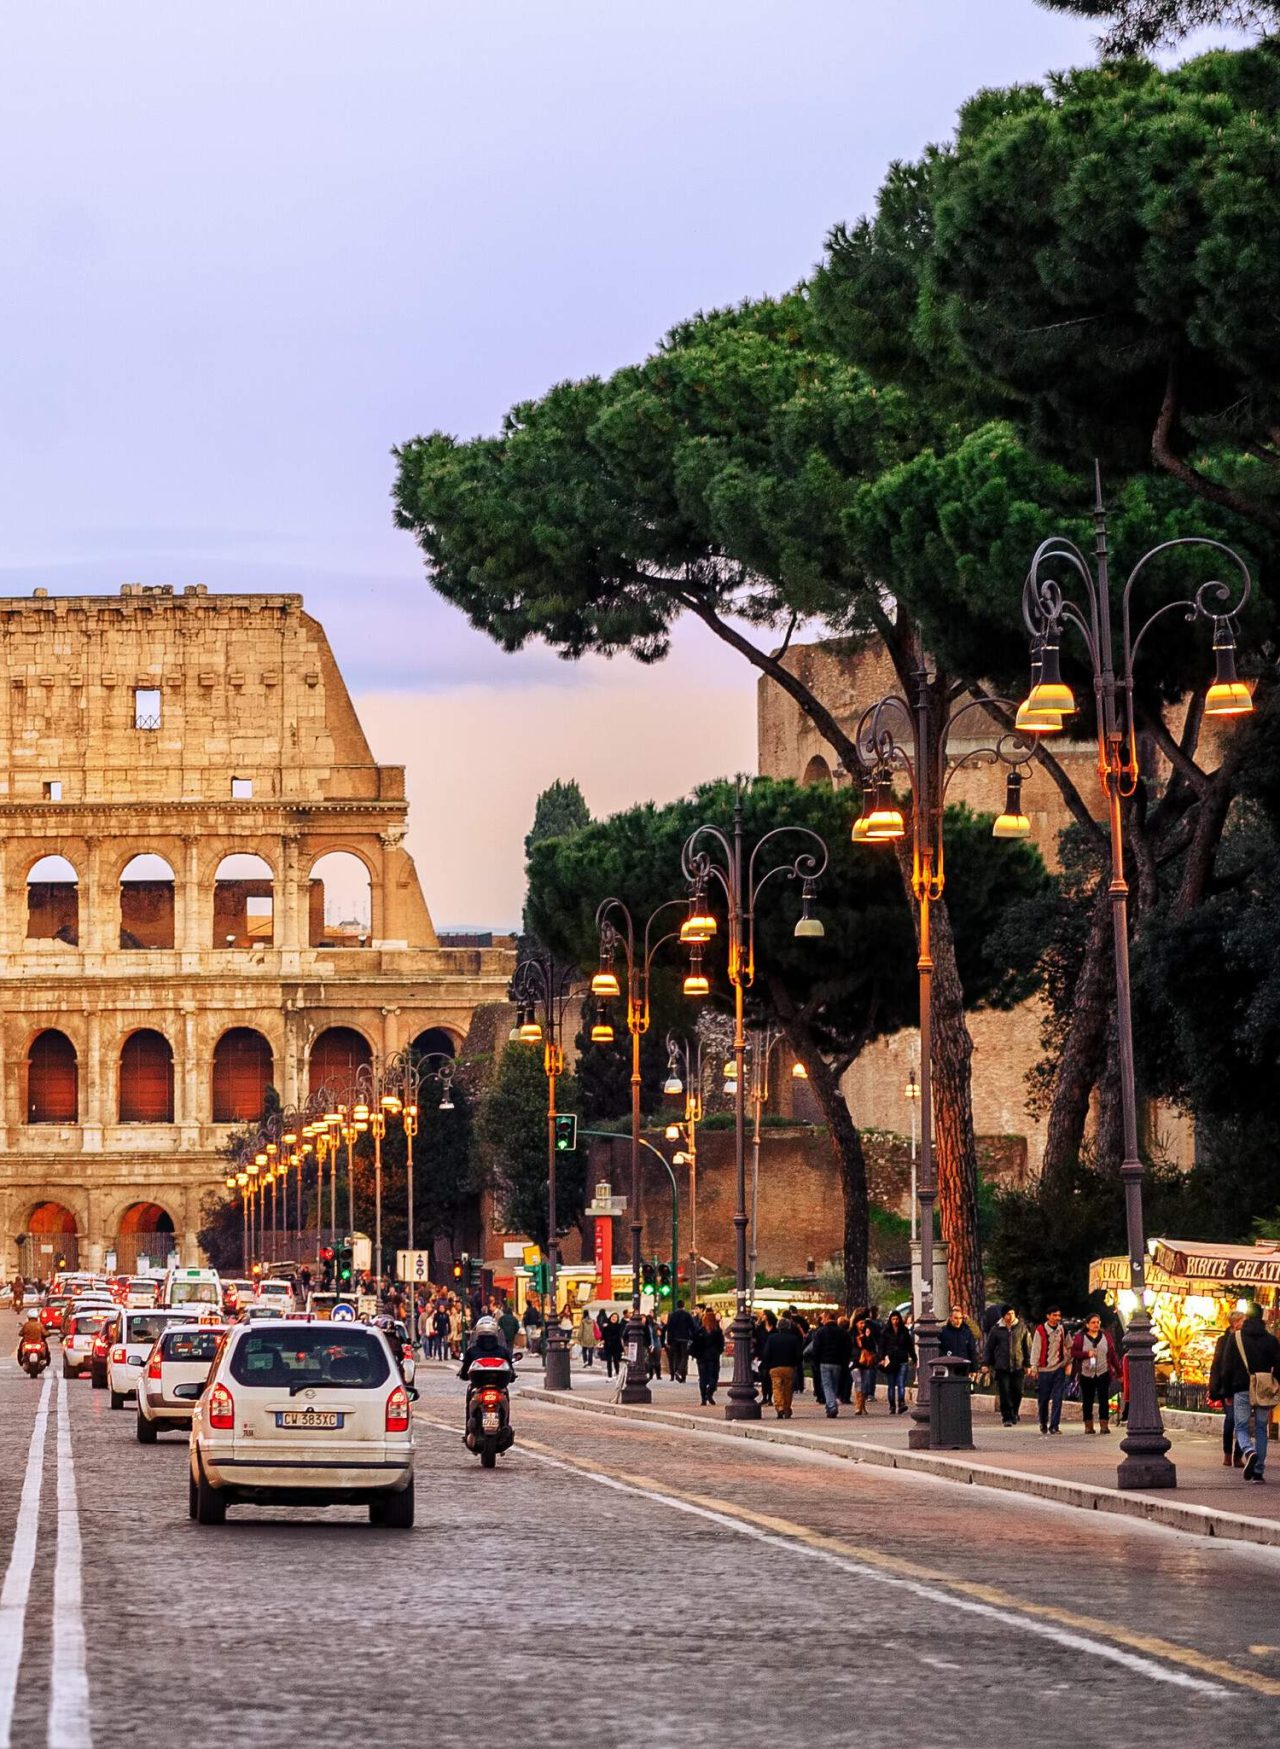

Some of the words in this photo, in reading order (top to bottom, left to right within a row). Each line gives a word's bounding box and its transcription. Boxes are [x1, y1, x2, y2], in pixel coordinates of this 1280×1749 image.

[1186, 1256, 1228, 1278] BIBITE
[1233, 1260, 1280, 1281] GELATI
[284, 1413, 298, 1425] CW
[302, 1414, 336, 1426] 383XC
